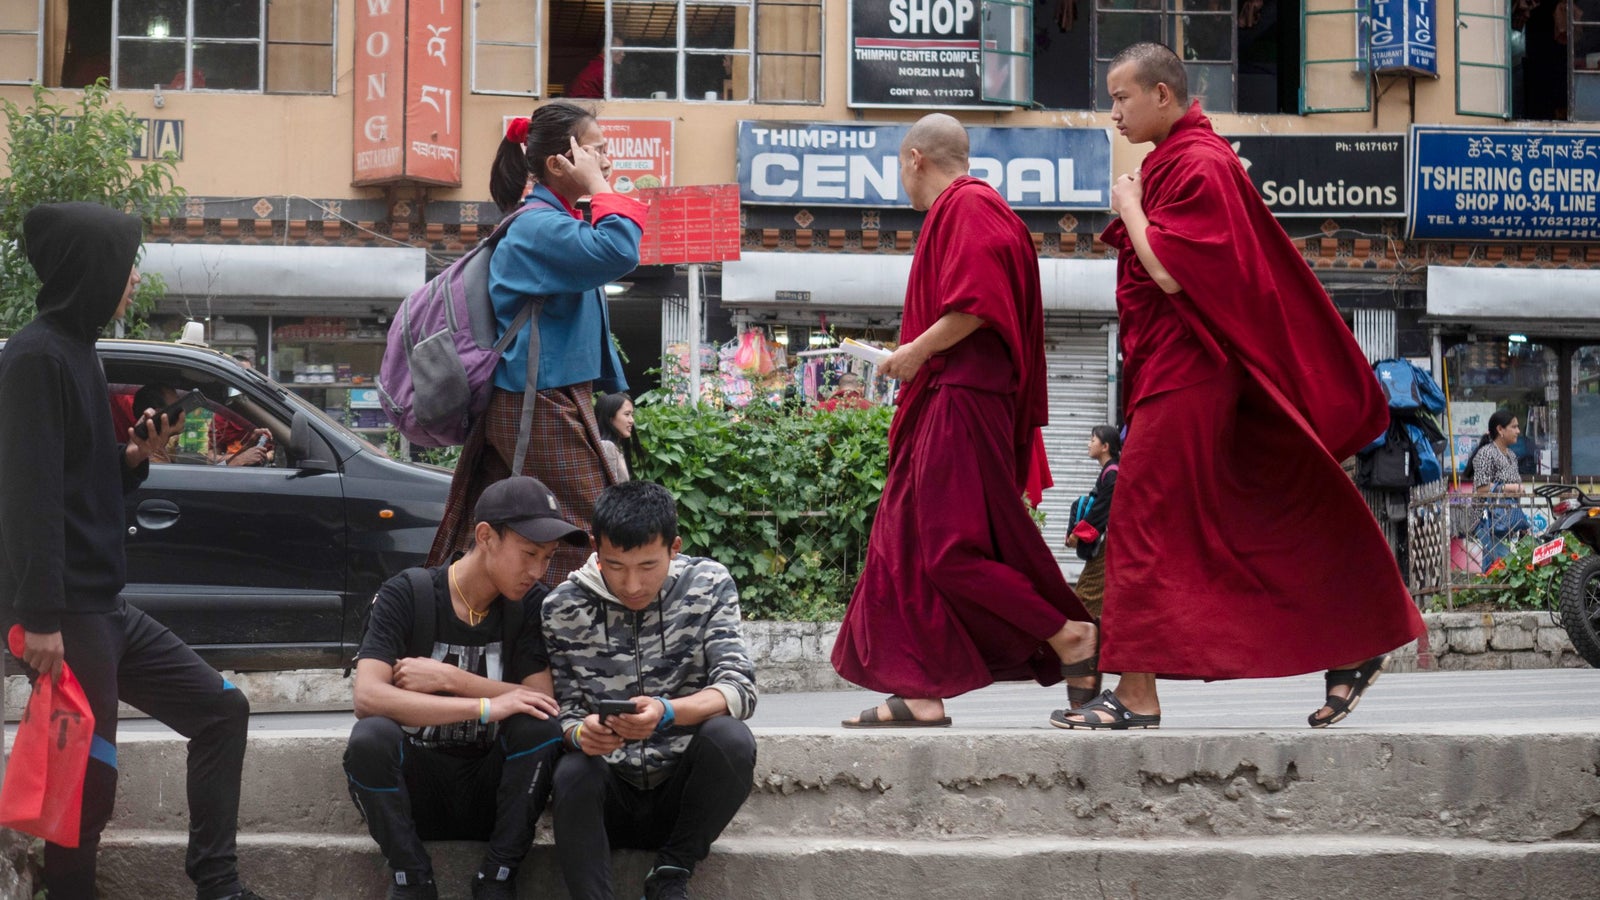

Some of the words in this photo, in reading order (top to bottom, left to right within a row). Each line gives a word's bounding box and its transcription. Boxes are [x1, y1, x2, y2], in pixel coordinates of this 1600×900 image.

[889, 0, 974, 34] SHOP
[1371, 0, 1393, 45] ING
[1415, 0, 1431, 43] ING
[855, 49, 898, 62] THIMPHU
[900, 51, 938, 62] CENTER
[940, 51, 980, 63] COMPLE
[898, 67, 940, 77] NORZIN
[889, 88, 914, 96] CONT
[933, 89, 974, 97] 17117373
[752, 128, 876, 149] THIMPHU
[1335, 142, 1352, 151] Ph:
[1354, 142, 1399, 151] 16171617
[750, 153, 1102, 202] CENRAL
[1420, 166, 1522, 191] TSHERING
[1262, 179, 1397, 206] Solutions
[1455, 193, 1499, 211] SHOP
[1504, 194, 1555, 214] NO-34,
[1560, 195, 1596, 212] LINE
[1428, 215, 1453, 225] TEL
[1472, 216, 1525, 226] 334417,
